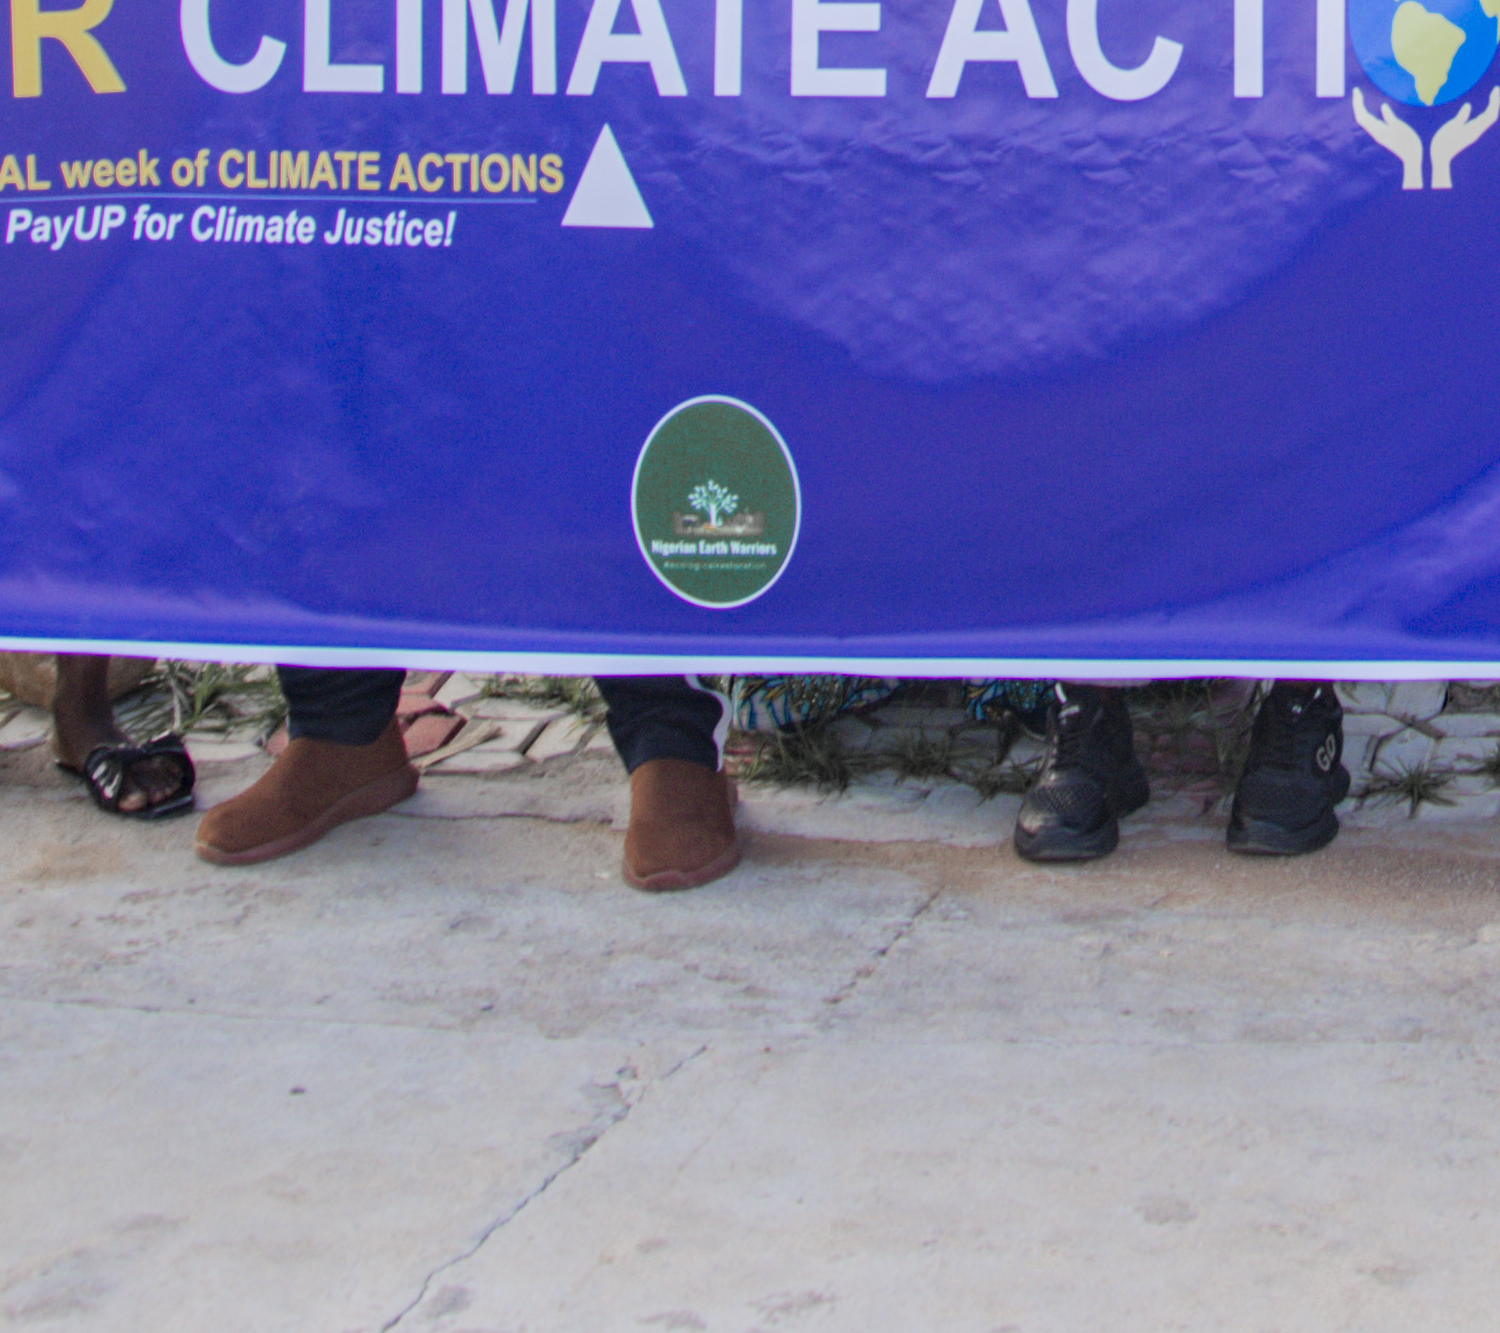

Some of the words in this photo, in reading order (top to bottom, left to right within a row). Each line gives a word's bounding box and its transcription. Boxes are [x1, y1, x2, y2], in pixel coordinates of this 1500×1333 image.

[59, 148, 161, 189] week
[171, 148, 209, 188] of
[218, 149, 380, 190] CLIMATE
[389, 153, 565, 194] ACTIONS
[4, 205, 127, 251] PayUP
[131, 204, 184, 242] for
[190, 205, 317, 247] Climate
[323, 209, 457, 249] Justice!
[651, 539, 697, 557] Nigerian
[698, 539, 728, 555] Earth
[730, 539, 777, 556] Warriors
